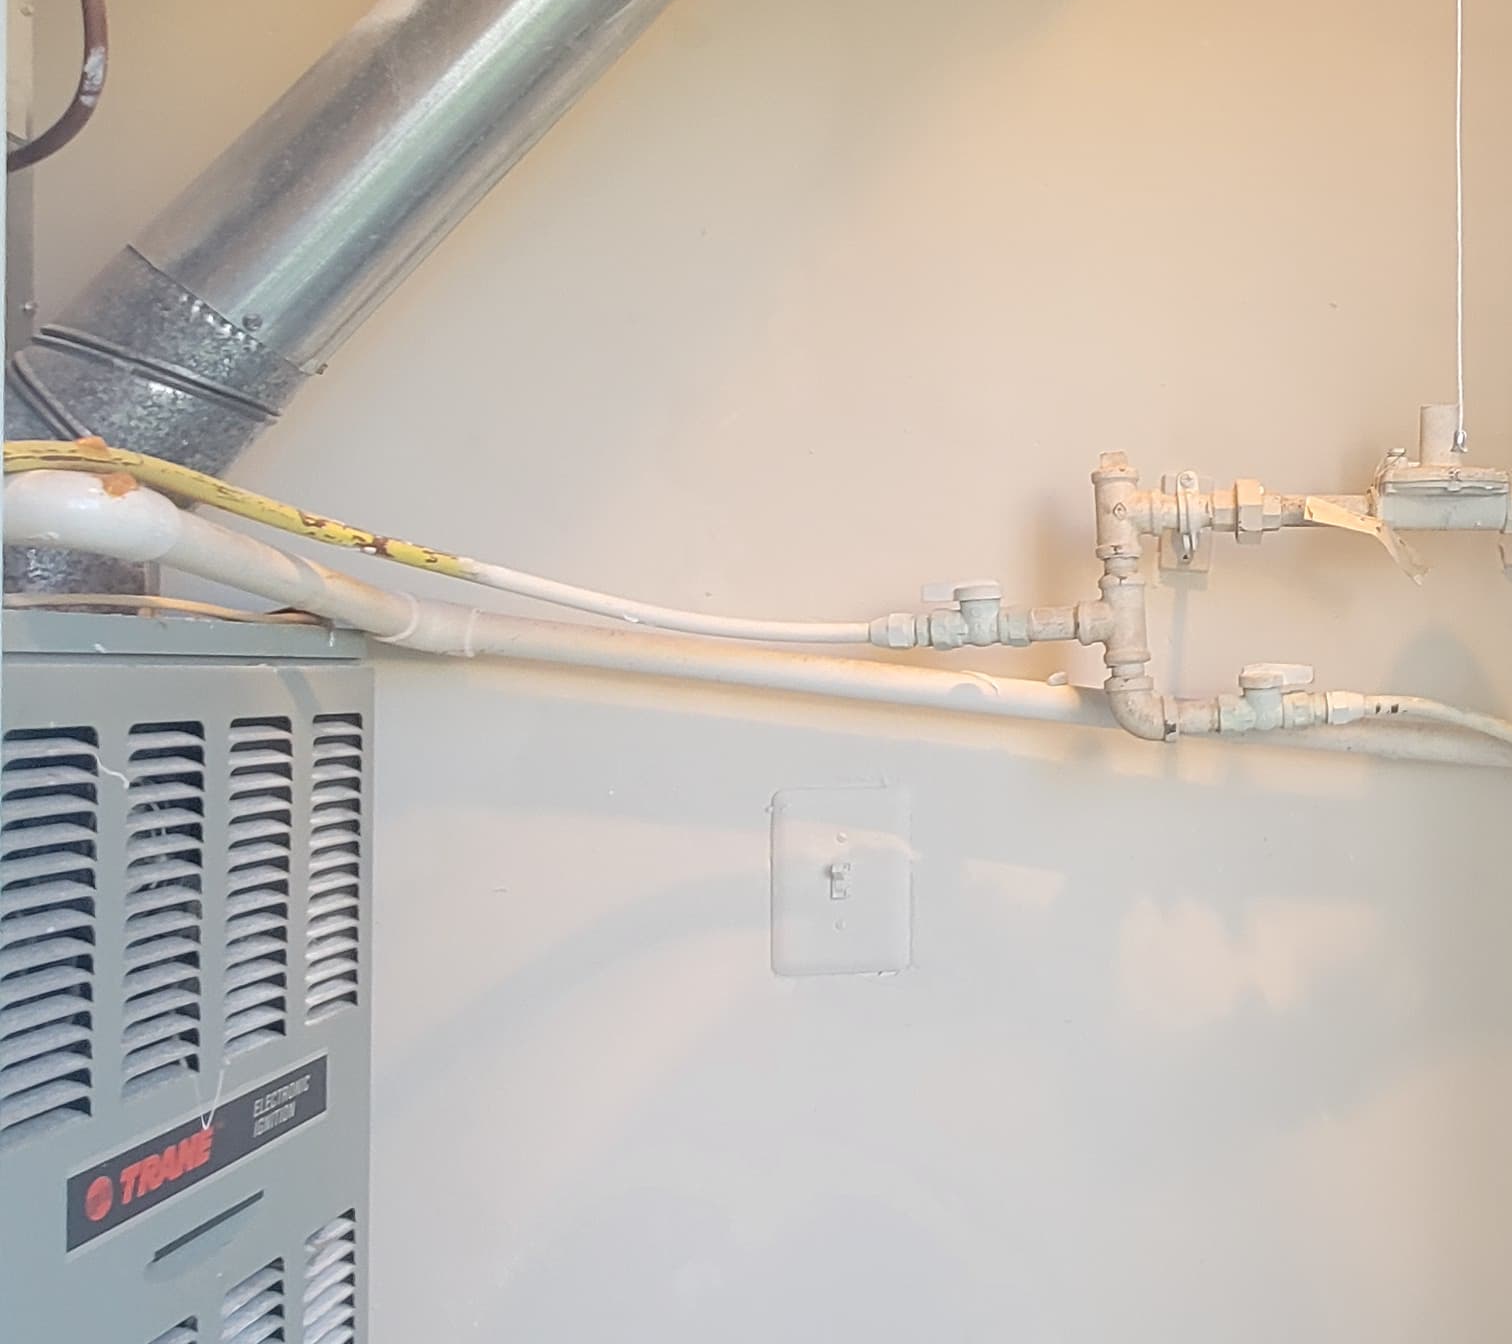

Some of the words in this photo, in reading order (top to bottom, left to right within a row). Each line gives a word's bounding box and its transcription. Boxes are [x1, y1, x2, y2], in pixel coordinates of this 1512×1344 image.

[254, 1075, 311, 1117] ELECTRONIC
[254, 1102, 295, 1137] IGNITION
[120, 1126, 214, 1205] TRANE
